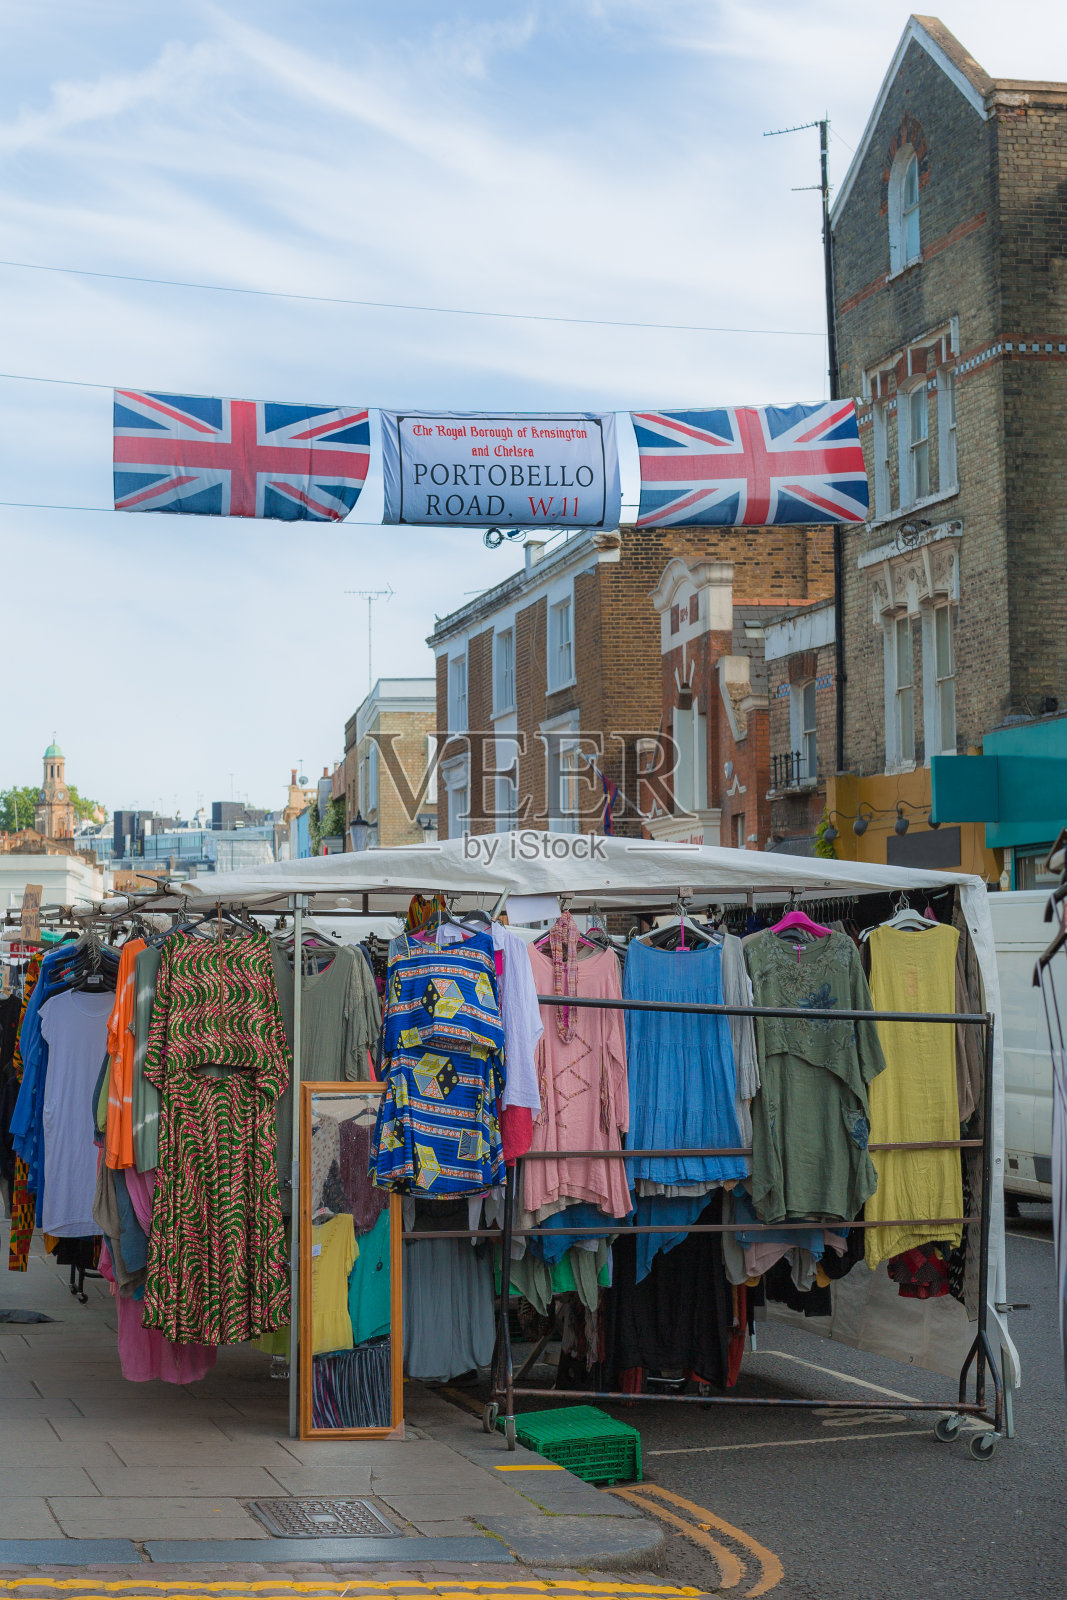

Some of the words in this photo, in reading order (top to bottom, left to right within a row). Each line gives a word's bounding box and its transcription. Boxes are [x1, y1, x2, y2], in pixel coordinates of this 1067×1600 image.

[412, 425, 433, 437] The
[435, 425, 467, 440] Royal
[470, 426, 513, 441] Borough
[517, 427, 528, 438] of
[531, 426, 587, 442] Kensington
[471, 444, 490, 457] and
[494, 444, 535, 457] Chelsea
[413, 463, 594, 488] PORTOBELLO
[527, 496, 579, 517] W.11
